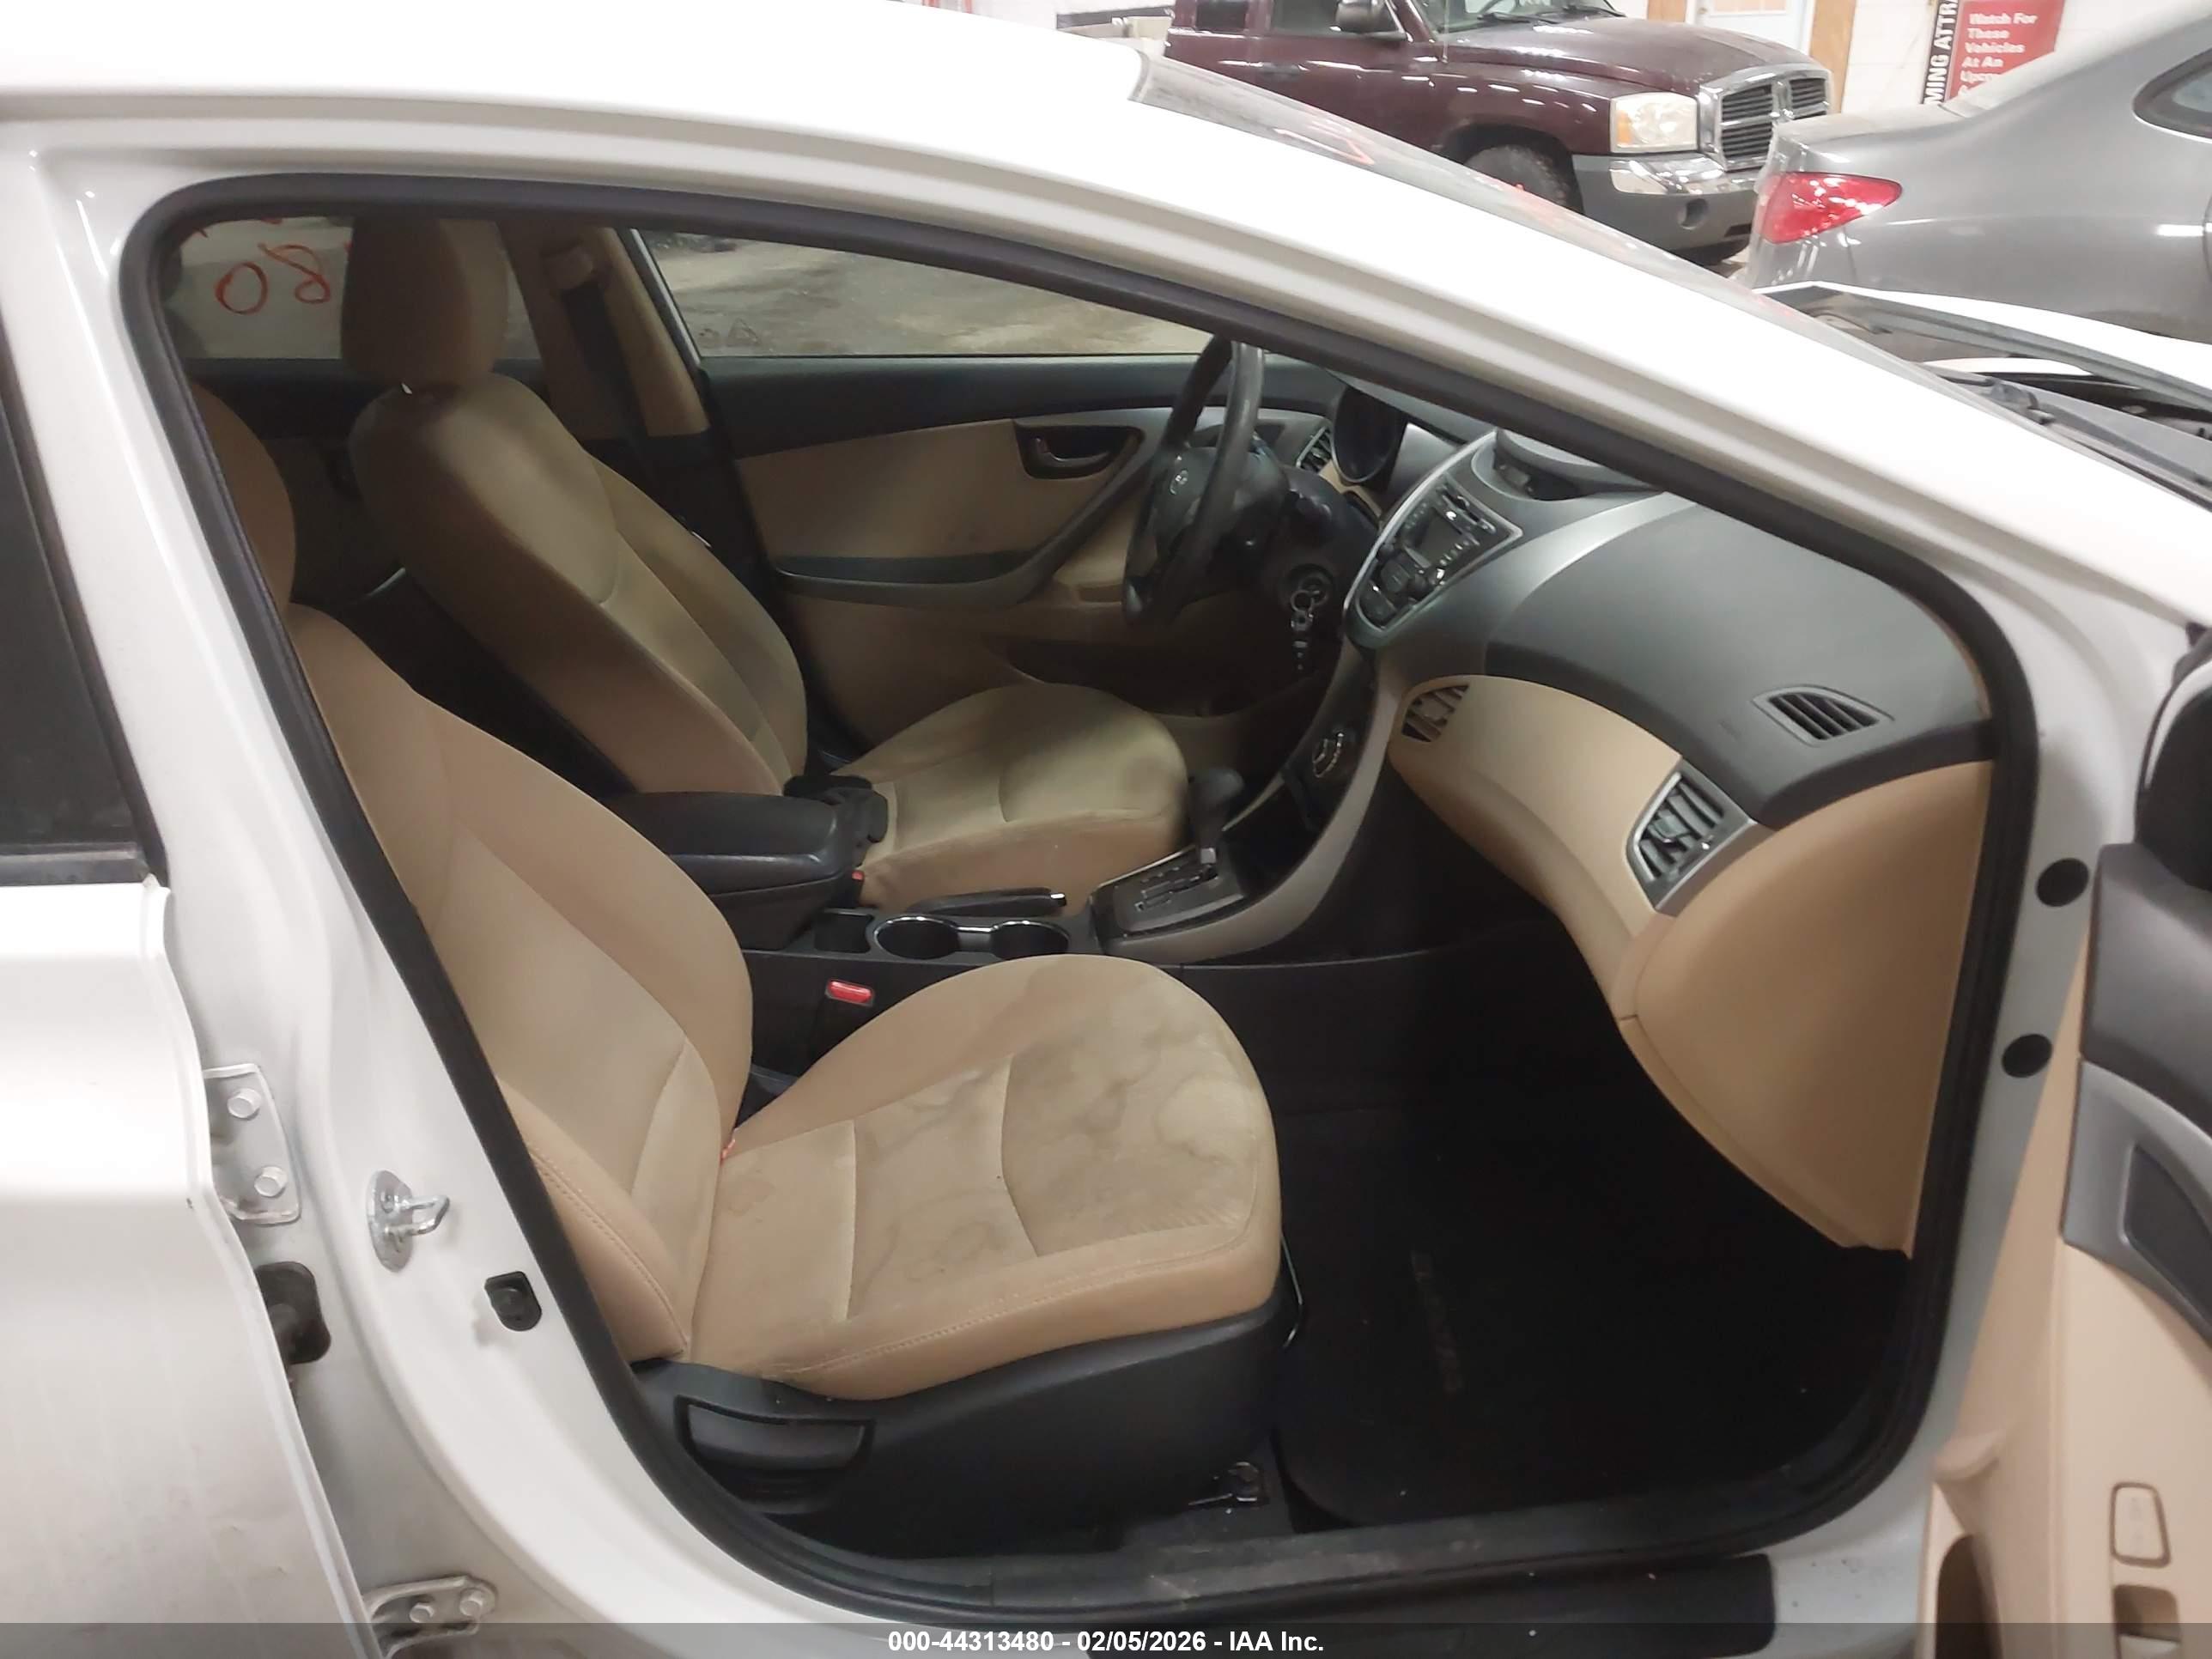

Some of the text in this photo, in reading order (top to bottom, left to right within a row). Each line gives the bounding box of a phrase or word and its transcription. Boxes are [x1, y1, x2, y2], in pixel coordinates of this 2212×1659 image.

[2014, 13, 2038, 24] For
[1934, 0, 1959, 50] ATTR
[1967, 27, 2010, 39] These
[1964, 41, 2026, 53] Vehicles
